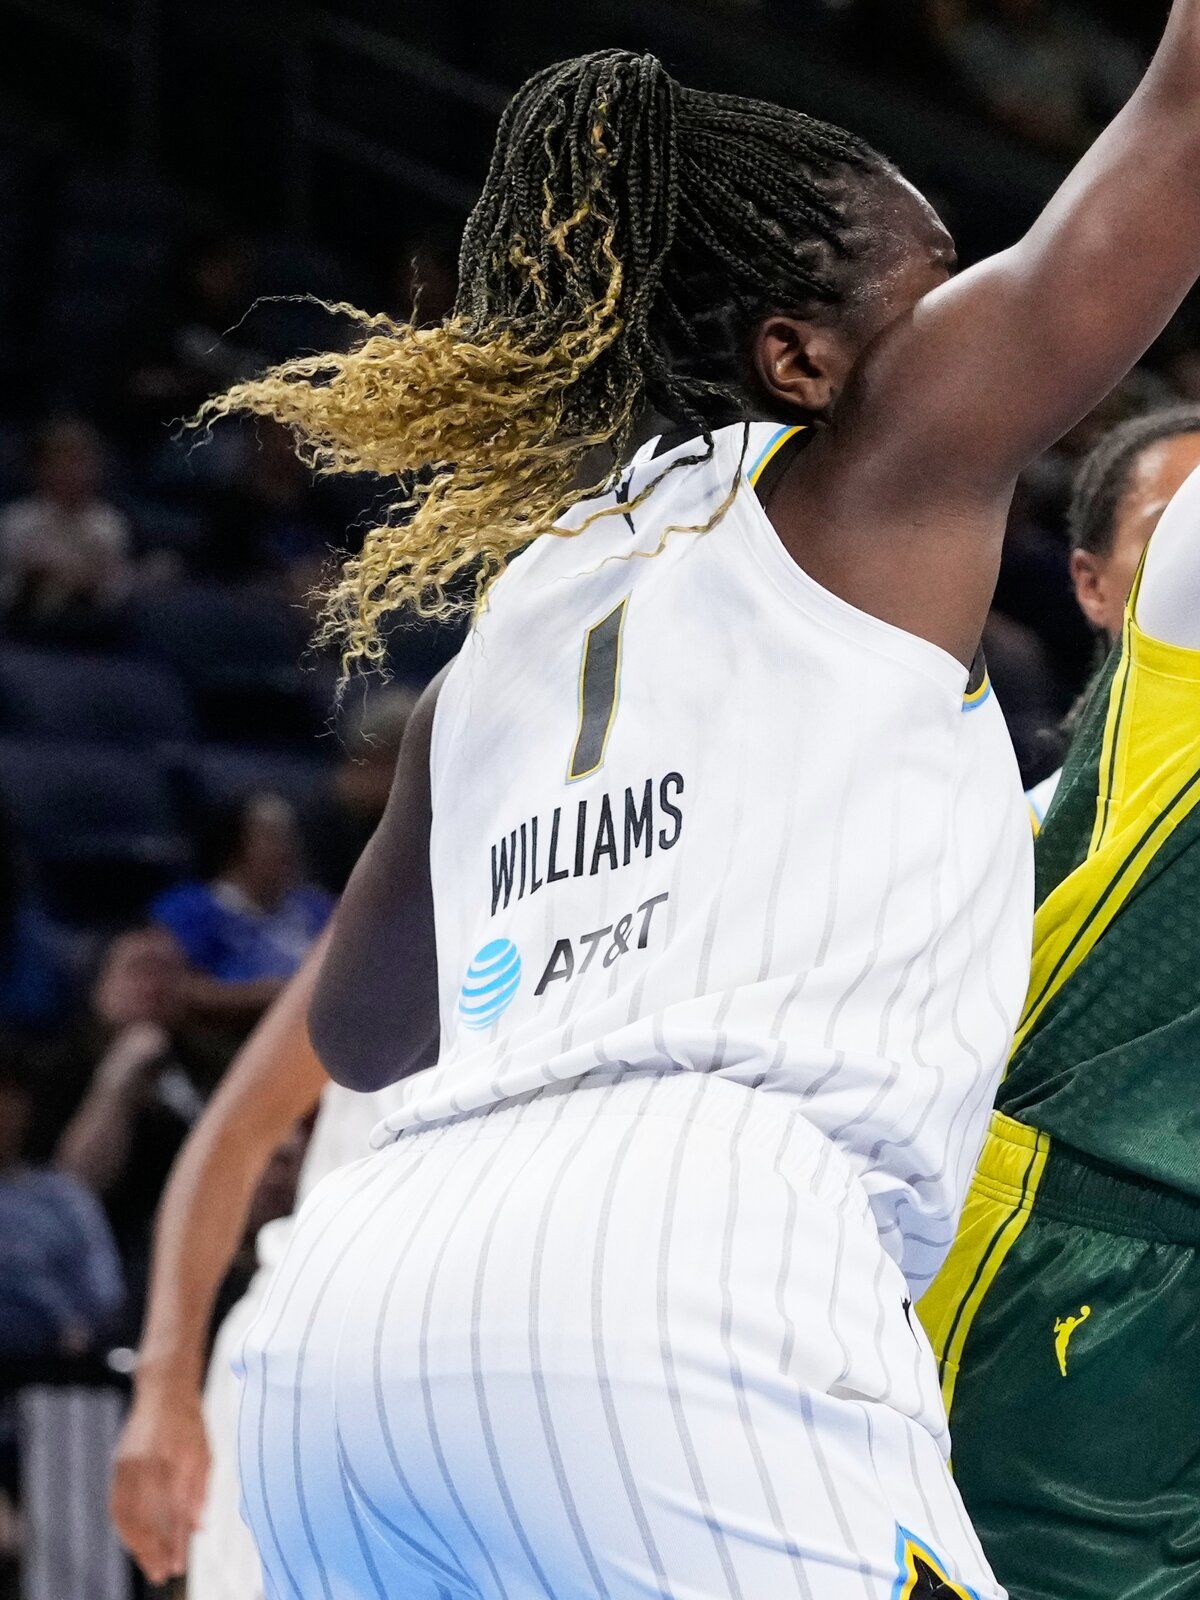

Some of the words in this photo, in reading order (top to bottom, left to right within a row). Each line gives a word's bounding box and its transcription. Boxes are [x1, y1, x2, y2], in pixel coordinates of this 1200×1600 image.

[566, 592, 632, 785] 1
[490, 771, 685, 918] WILLIAMS
[533, 892, 669, 996] AT&T
